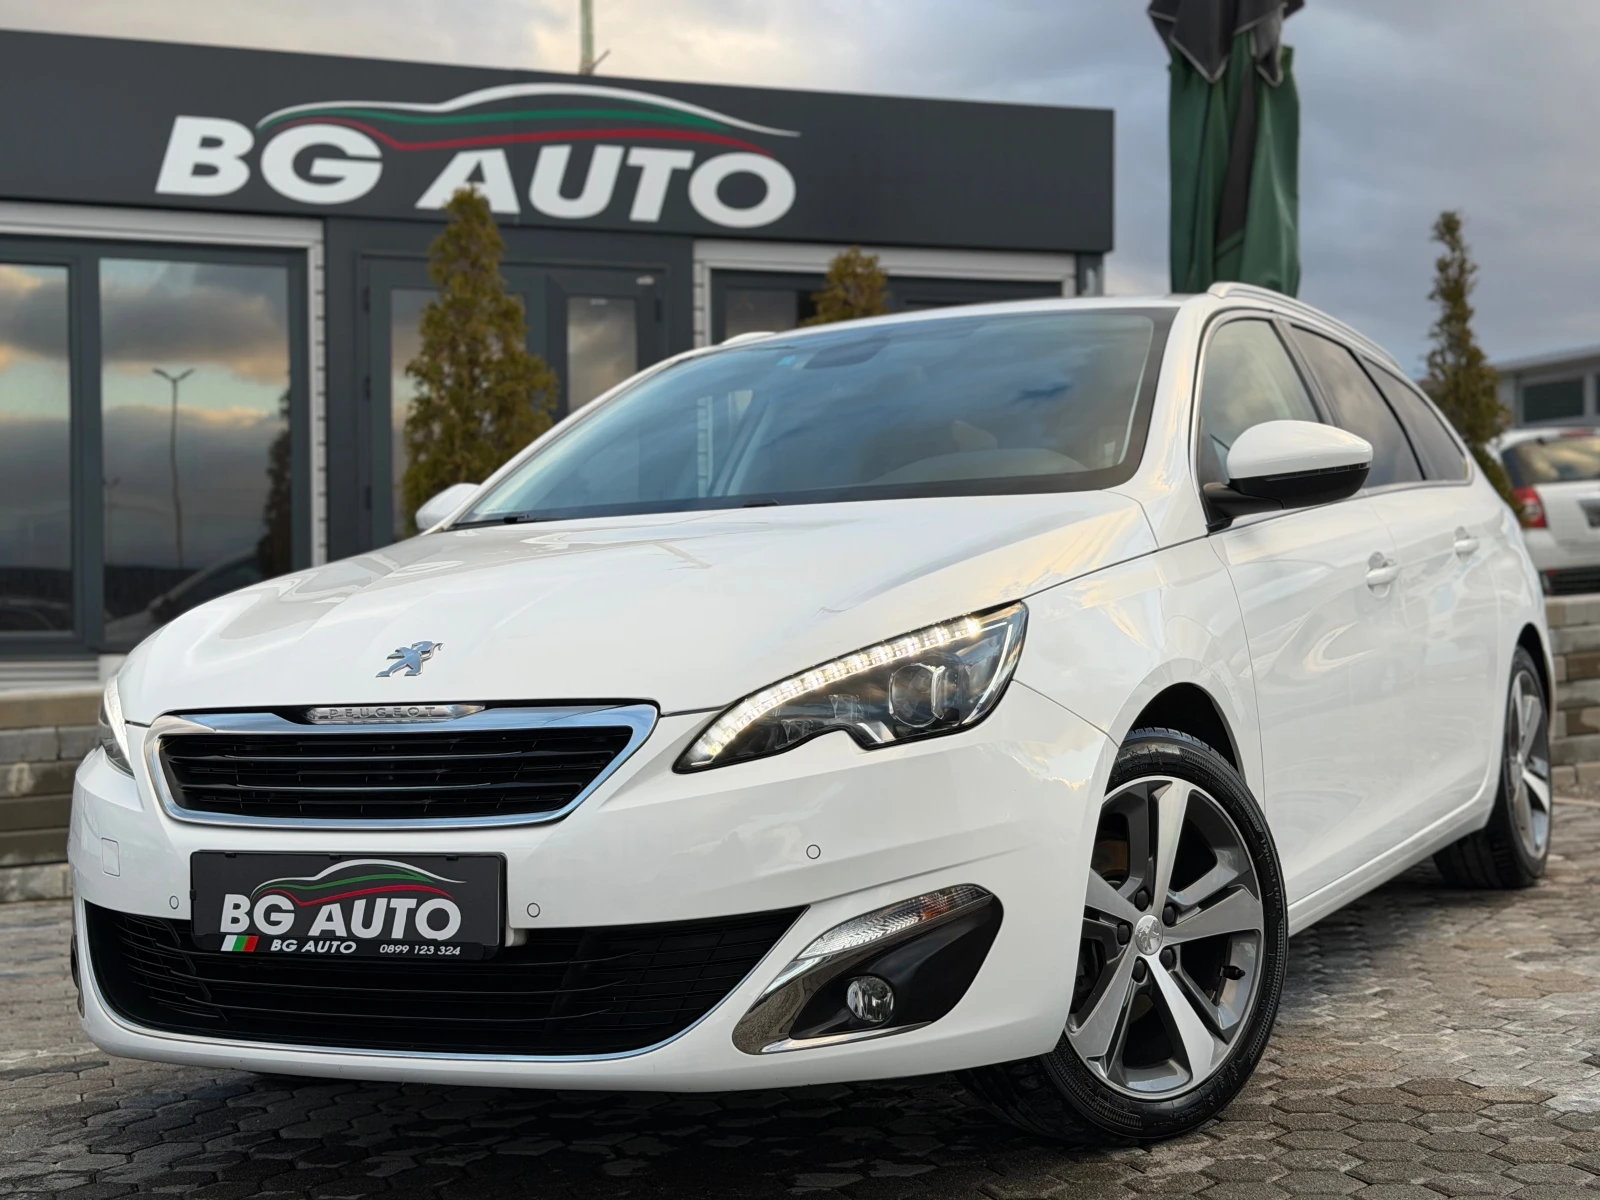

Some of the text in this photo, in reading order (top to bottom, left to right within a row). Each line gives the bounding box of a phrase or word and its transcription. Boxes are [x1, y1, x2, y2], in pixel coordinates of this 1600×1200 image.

[155, 115, 796, 228] BG AUTO
[328, 706, 436, 719] PEUGEOT
[220, 893, 462, 941] BG AUTO
[270, 939, 357, 954] BG AUTO
[379, 944, 461, 956] 0899 123 324
